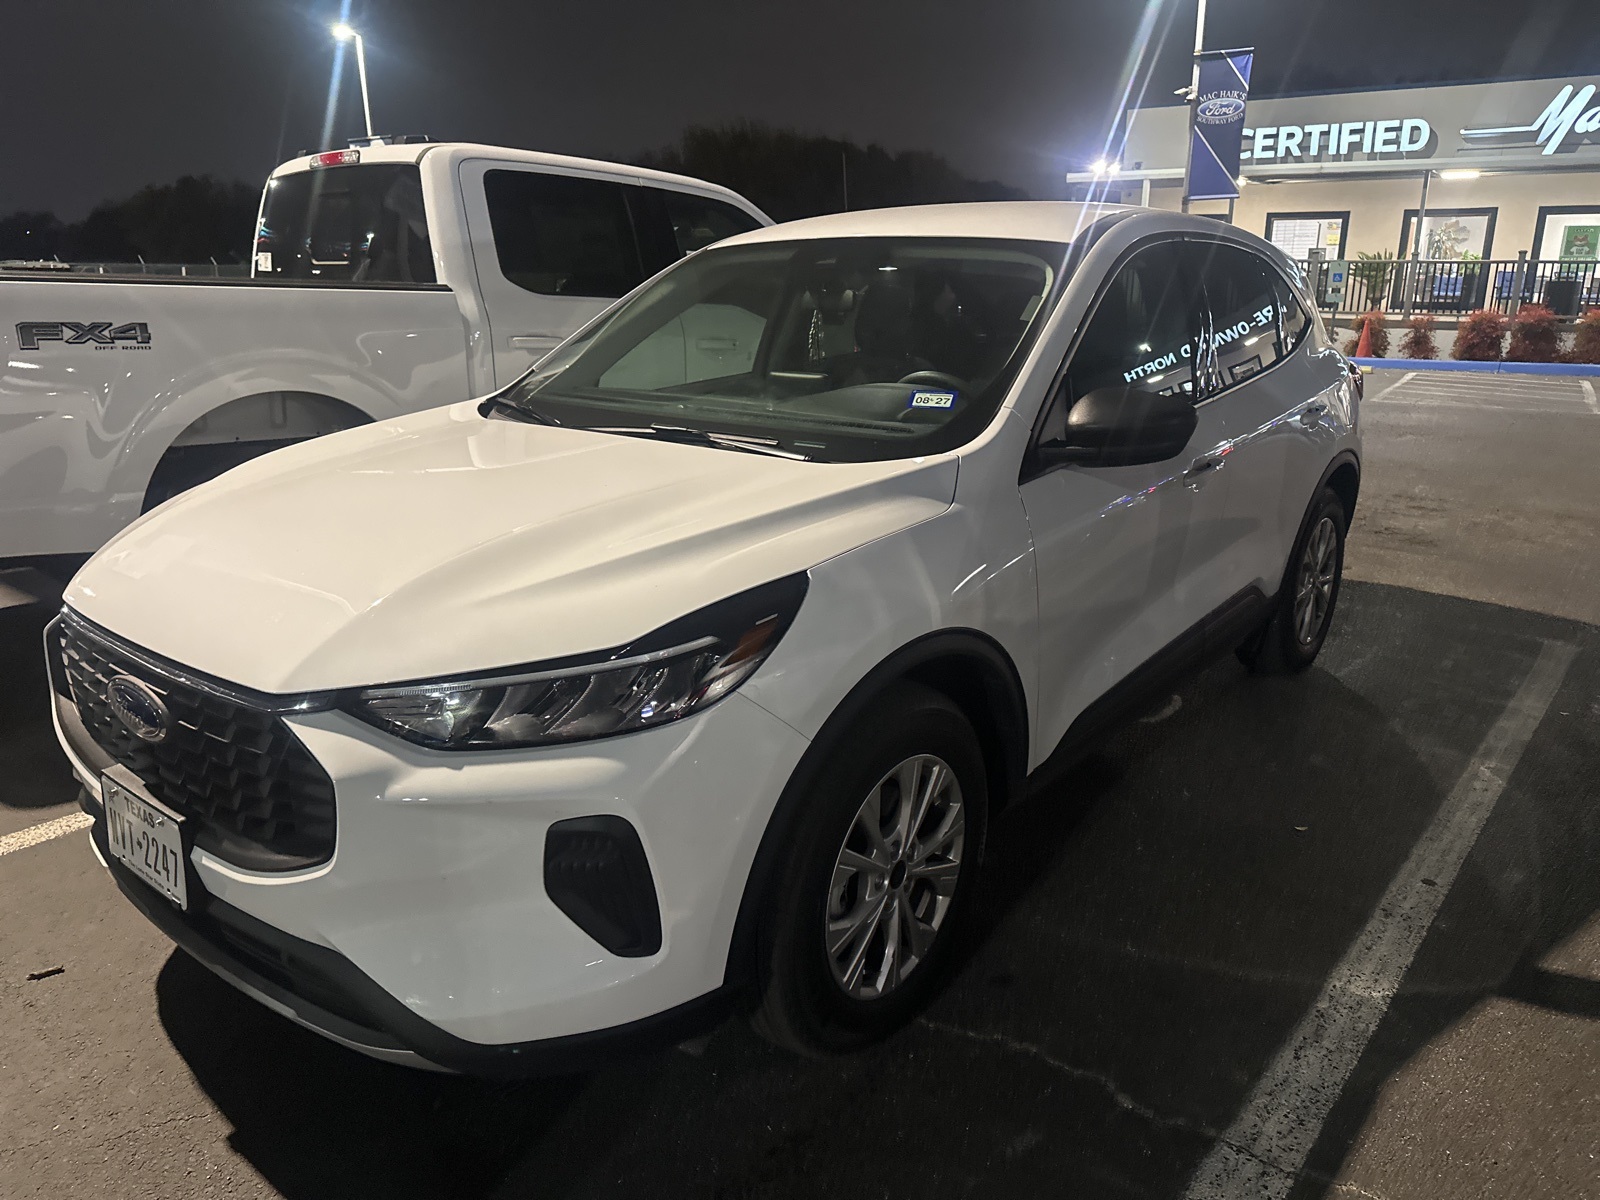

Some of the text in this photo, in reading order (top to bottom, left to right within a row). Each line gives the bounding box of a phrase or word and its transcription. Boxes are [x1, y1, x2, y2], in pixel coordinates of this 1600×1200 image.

[1199, 90, 1247, 103] MAC HAIK'S
[1205, 101, 1236, 116] Ford
[1197, 112, 1243, 125] SOUTHWAY FORD
[15, 321, 152, 351] FX4
[124, 796, 156, 829] TEXAS
